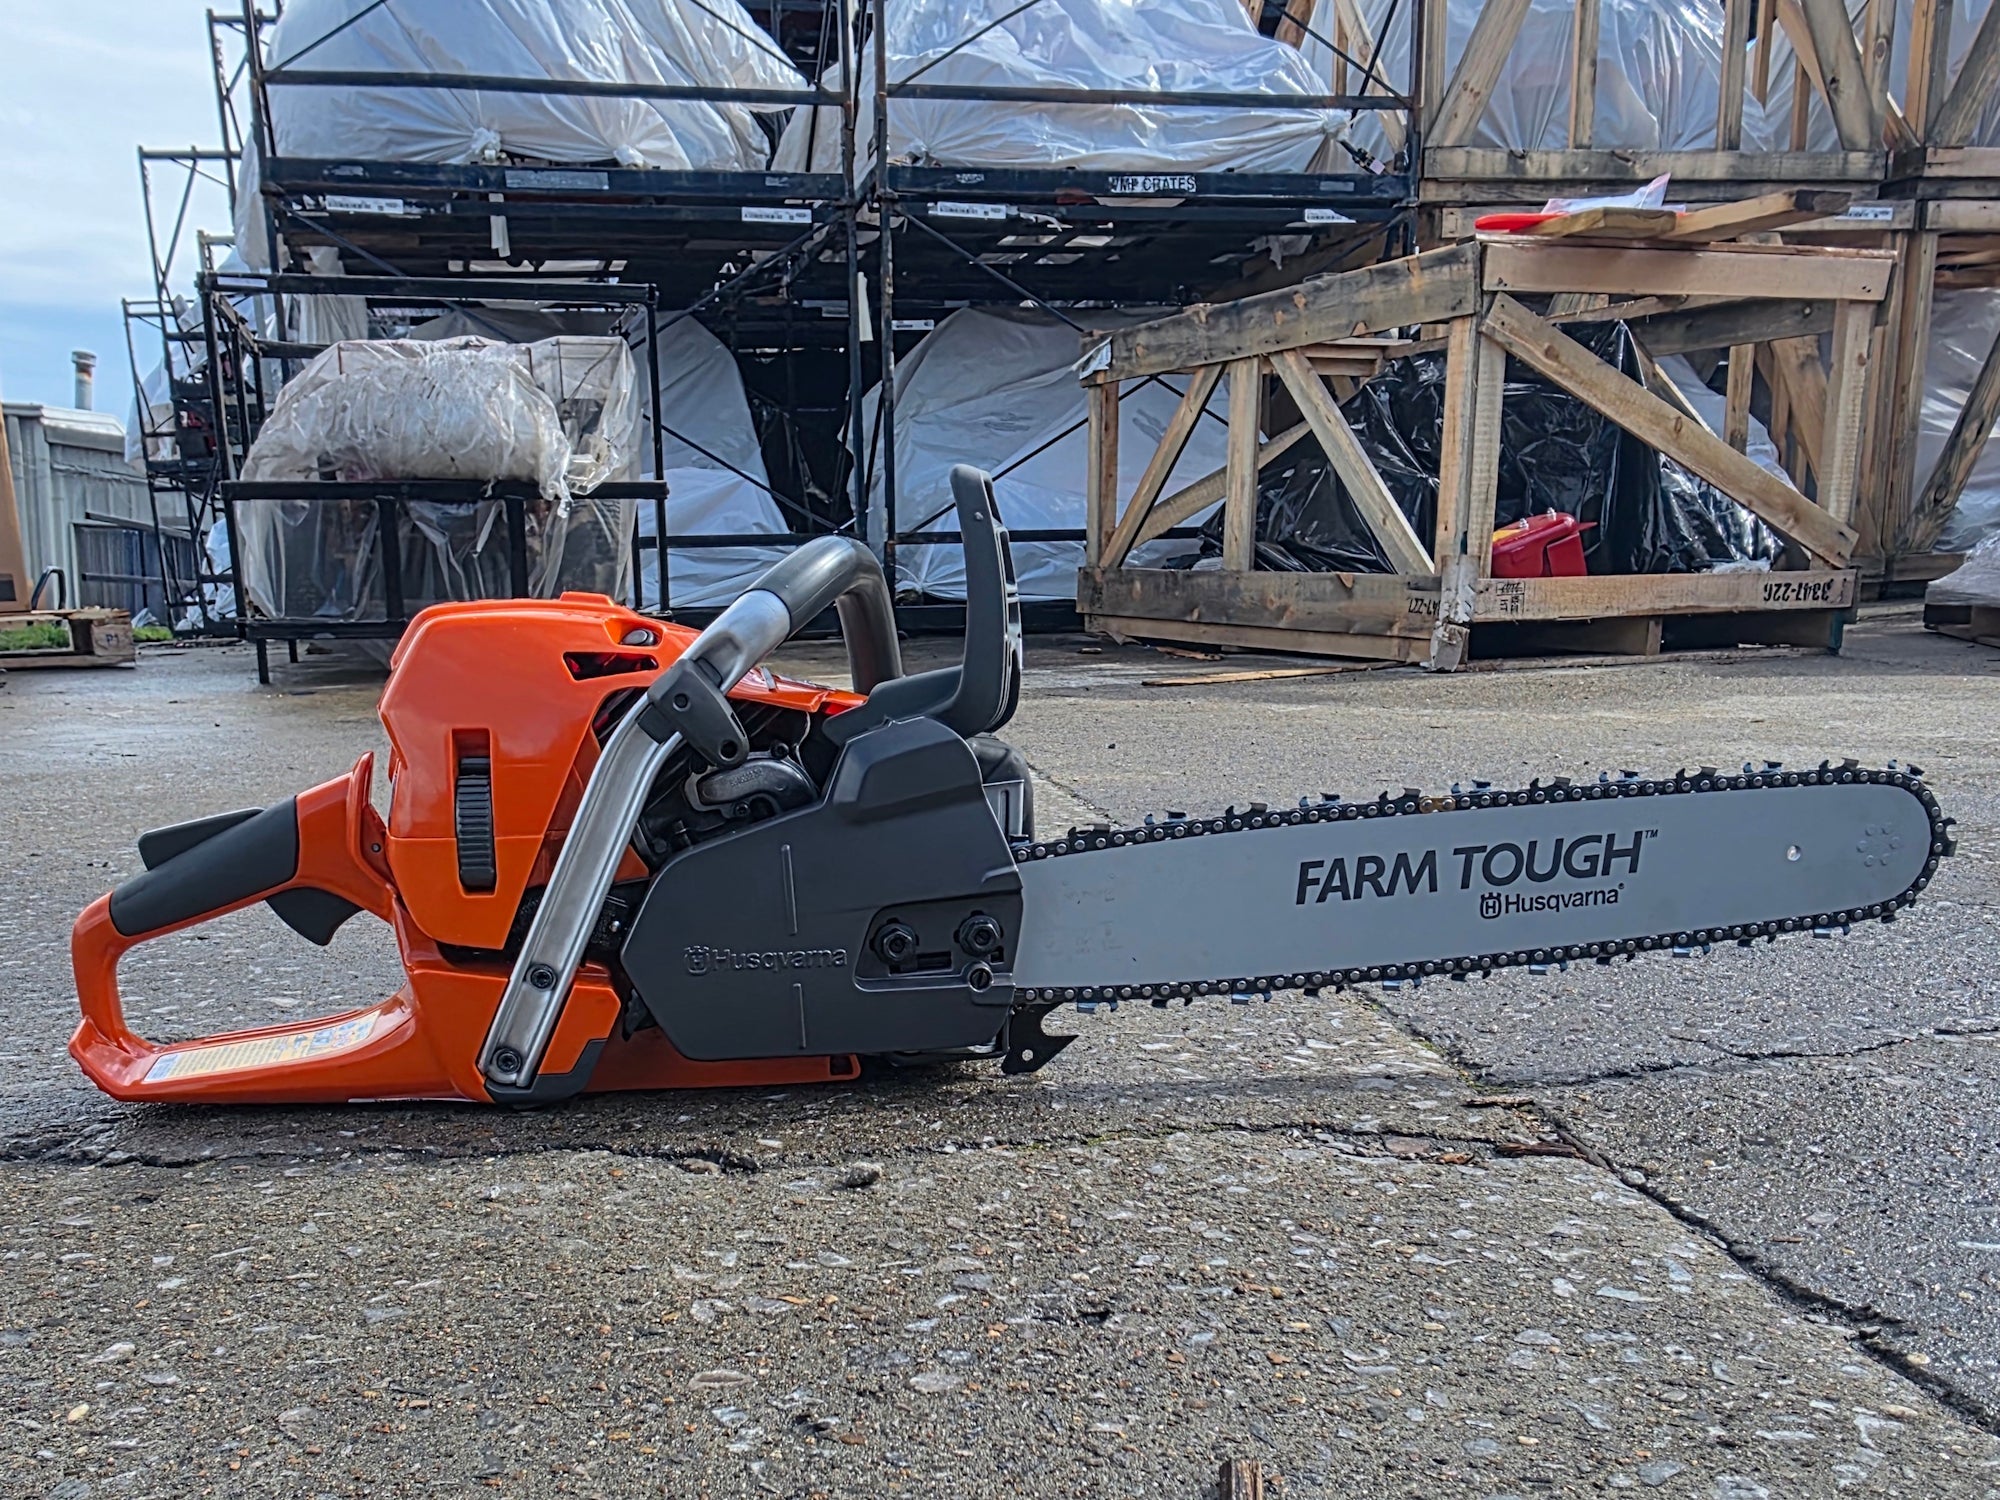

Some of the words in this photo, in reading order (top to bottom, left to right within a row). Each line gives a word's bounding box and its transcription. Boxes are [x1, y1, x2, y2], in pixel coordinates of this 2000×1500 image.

[1143, 175, 1196, 191] CRATES
[1296, 850, 1438, 905] FARM
[712, 948, 848, 973] Husqvarna
